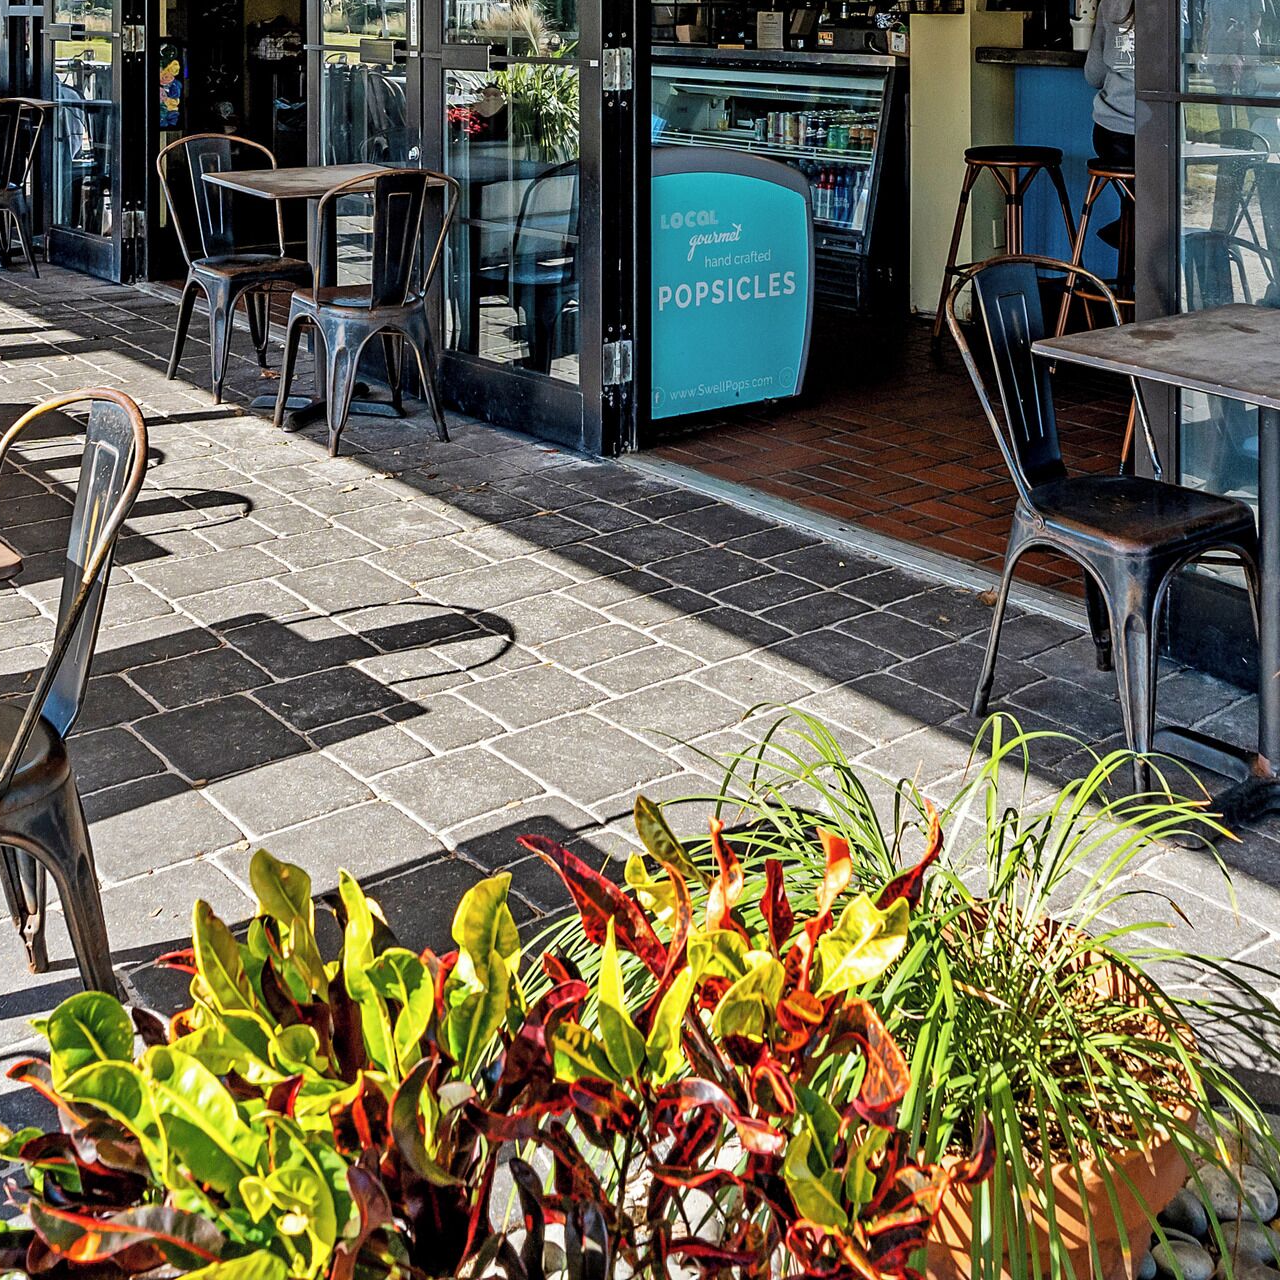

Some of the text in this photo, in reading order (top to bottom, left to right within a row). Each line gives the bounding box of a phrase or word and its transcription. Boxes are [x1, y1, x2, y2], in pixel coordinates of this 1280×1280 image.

[687, 223, 743, 262] gourmet
[704, 249, 771, 268] hand crafted
[658, 271, 797, 312] POPSICLES
[670, 377, 773, 401] www.SwellPops.com
